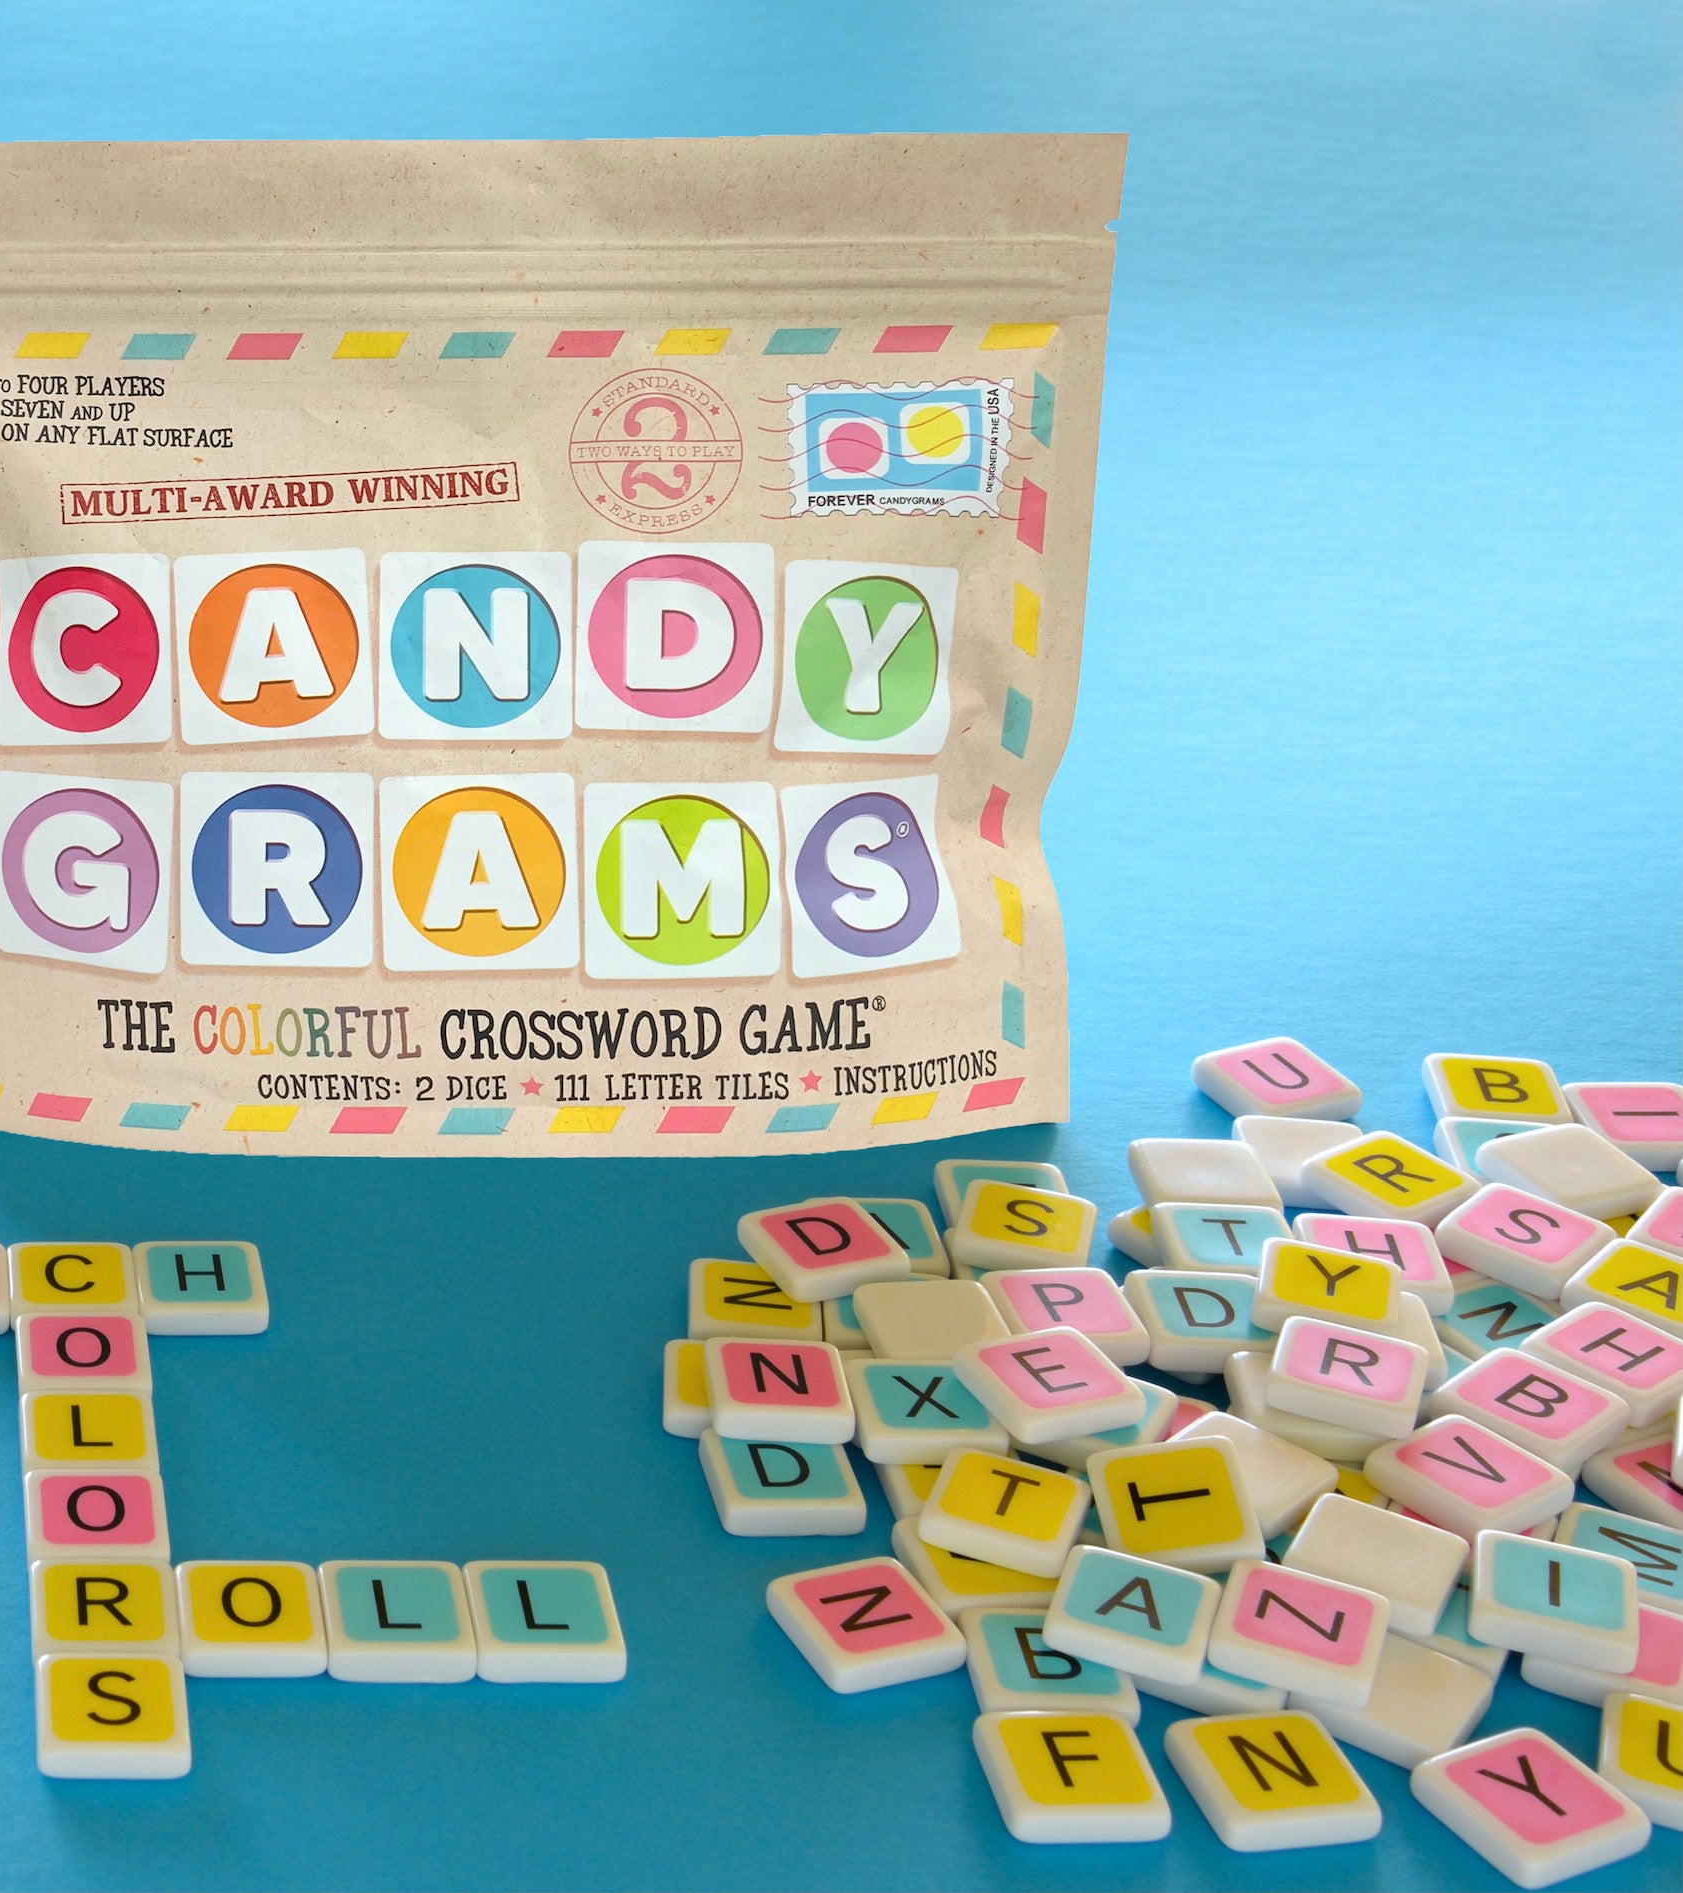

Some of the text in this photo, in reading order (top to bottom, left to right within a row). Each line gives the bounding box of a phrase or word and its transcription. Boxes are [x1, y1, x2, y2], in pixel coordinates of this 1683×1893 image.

[18, 375, 68, 395] FOUR
[75, 375, 165, 397] PLAYERS
[602, 376, 710, 408] STANDARD
[1, 398, 65, 419] SEVEN
[109, 402, 136, 422] UP
[1, 423, 29, 442] ON
[35, 425, 80, 444] ANY
[87, 426, 138, 446] FLAT
[143, 428, 233, 448] SURFACE
[576, 445, 735, 458] TWO WAYS TO PLAY
[986, 388, 1000, 493] DESIGNED IN THE USA
[70, 468, 510, 517] MULTI-AWARD WINNING
[808, 494, 945, 507] FOREVER CANDYGRAMS
[609, 502, 703, 527] EXPRESS
[29, 575, 926, 718] CANDY
[97, 998, 176, 1054] THE
[192, 1003, 423, 1060] COLORFUL
[439, 1003, 722, 1061] CROSSWORD
[257, 1049, 998, 1102] CONTENTS: 2 DICE 111 LETTER TILES INSTRUCTIONS
[1242, 1052, 1310, 1090] U
[1472, 1067, 1530, 1104] B
[1352, 1154, 1436, 1194] R
[785, 1216, 852, 1256] D
[1003, 1199, 1055, 1237] S
[1201, 1218, 1248, 1256] T
[1494, 1208, 1560, 1245] S
[1344, 1230, 1406, 1272] H
[1306, 1254, 1361, 1297] Y
[1616, 1270, 1680, 1311] A
[1030, 1282, 1084, 1323] P
[1173, 1286, 1236, 1328] D
[1010, 1346, 1088, 1394] E
[1319, 1337, 1380, 1387] R
[1579, 1326, 1666, 1373] H
[749, 1352, 809, 1395] N
[891, 1375, 960, 1419] X
[1494, 1373, 1569, 1418] B
[746, 1443, 810, 1488] D
[1420, 1435, 1507, 1484] V
[990, 1468, 1041, 1517] T
[1127, 1481, 1211, 1522] T
[75, 1576, 571, 1630] ROLL
[1094, 1576, 1162, 1632] A
[1040, 1730, 1099, 1788] F
[1227, 1730, 1319, 1792] N
[1476, 1754, 1567, 1818] Y
